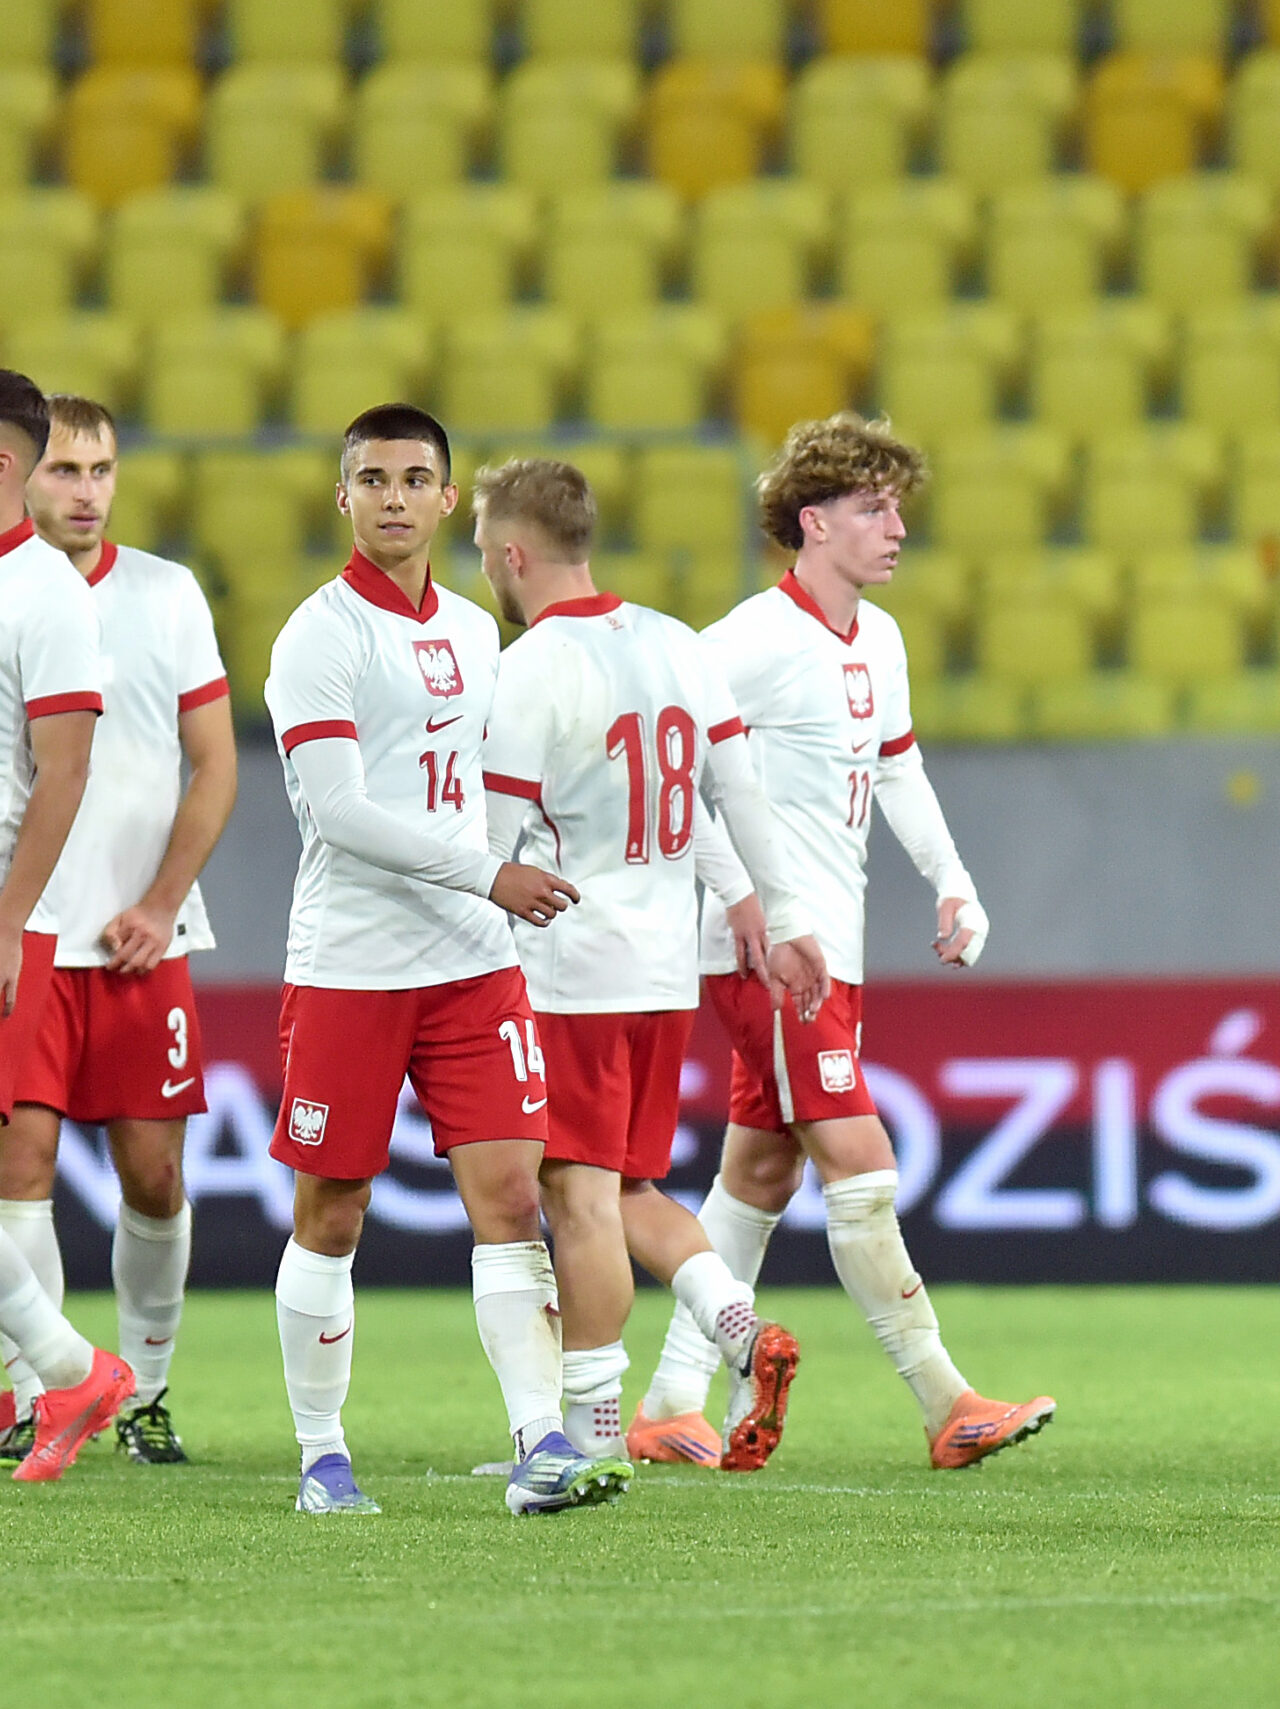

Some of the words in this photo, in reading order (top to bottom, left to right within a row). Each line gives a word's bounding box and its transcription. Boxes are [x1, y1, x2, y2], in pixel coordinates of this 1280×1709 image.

[419, 750, 465, 813] 14
[606, 705, 697, 864] 18
[846, 770, 870, 828] 11
[167, 1006, 188, 1069] 3
[498, 1019, 545, 1082] 14
